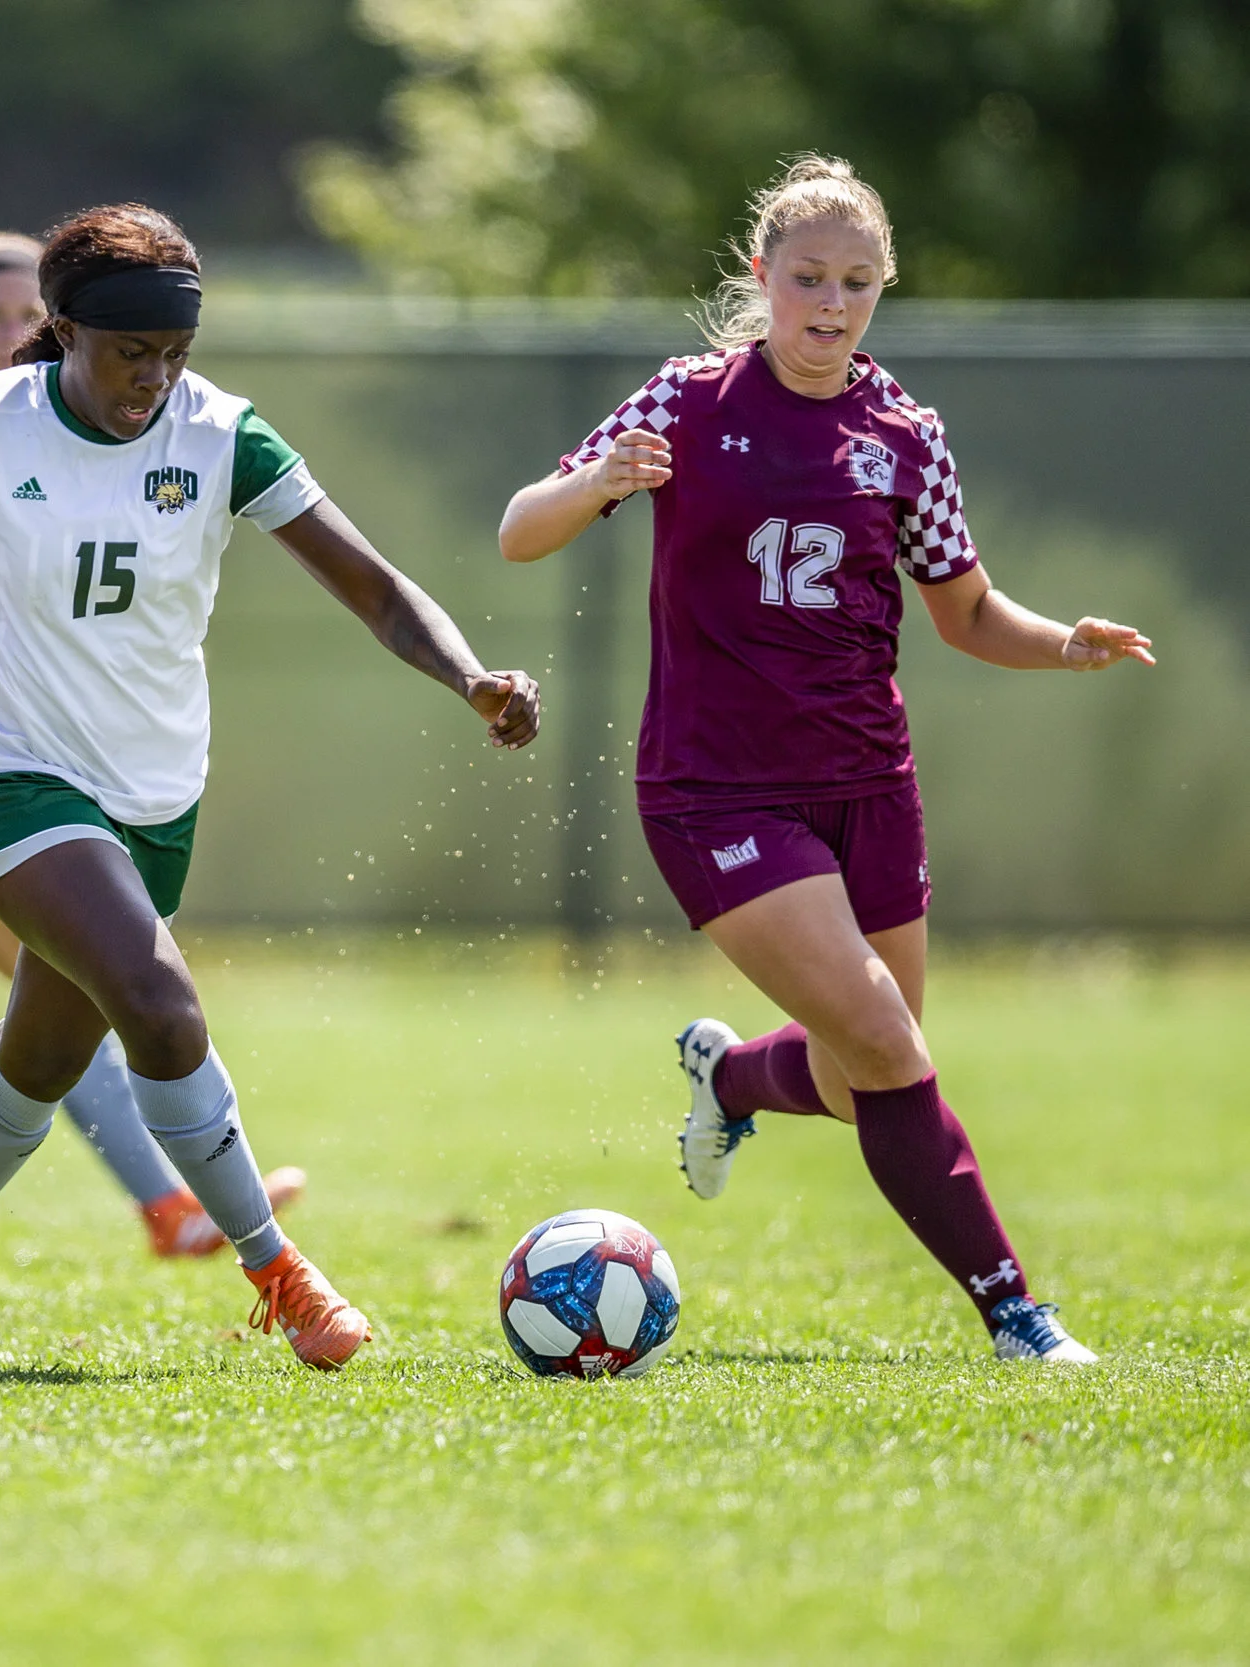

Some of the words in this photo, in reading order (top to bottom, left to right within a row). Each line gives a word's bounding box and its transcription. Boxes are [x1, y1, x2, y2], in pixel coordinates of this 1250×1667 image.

[862, 442, 887, 460] SIU
[12, 490, 47, 501] adidas
[144, 466, 198, 502] OHIO
[72, 541, 138, 619] 15
[747, 517, 845, 608] 12
[710, 835, 760, 871] VALLEY
